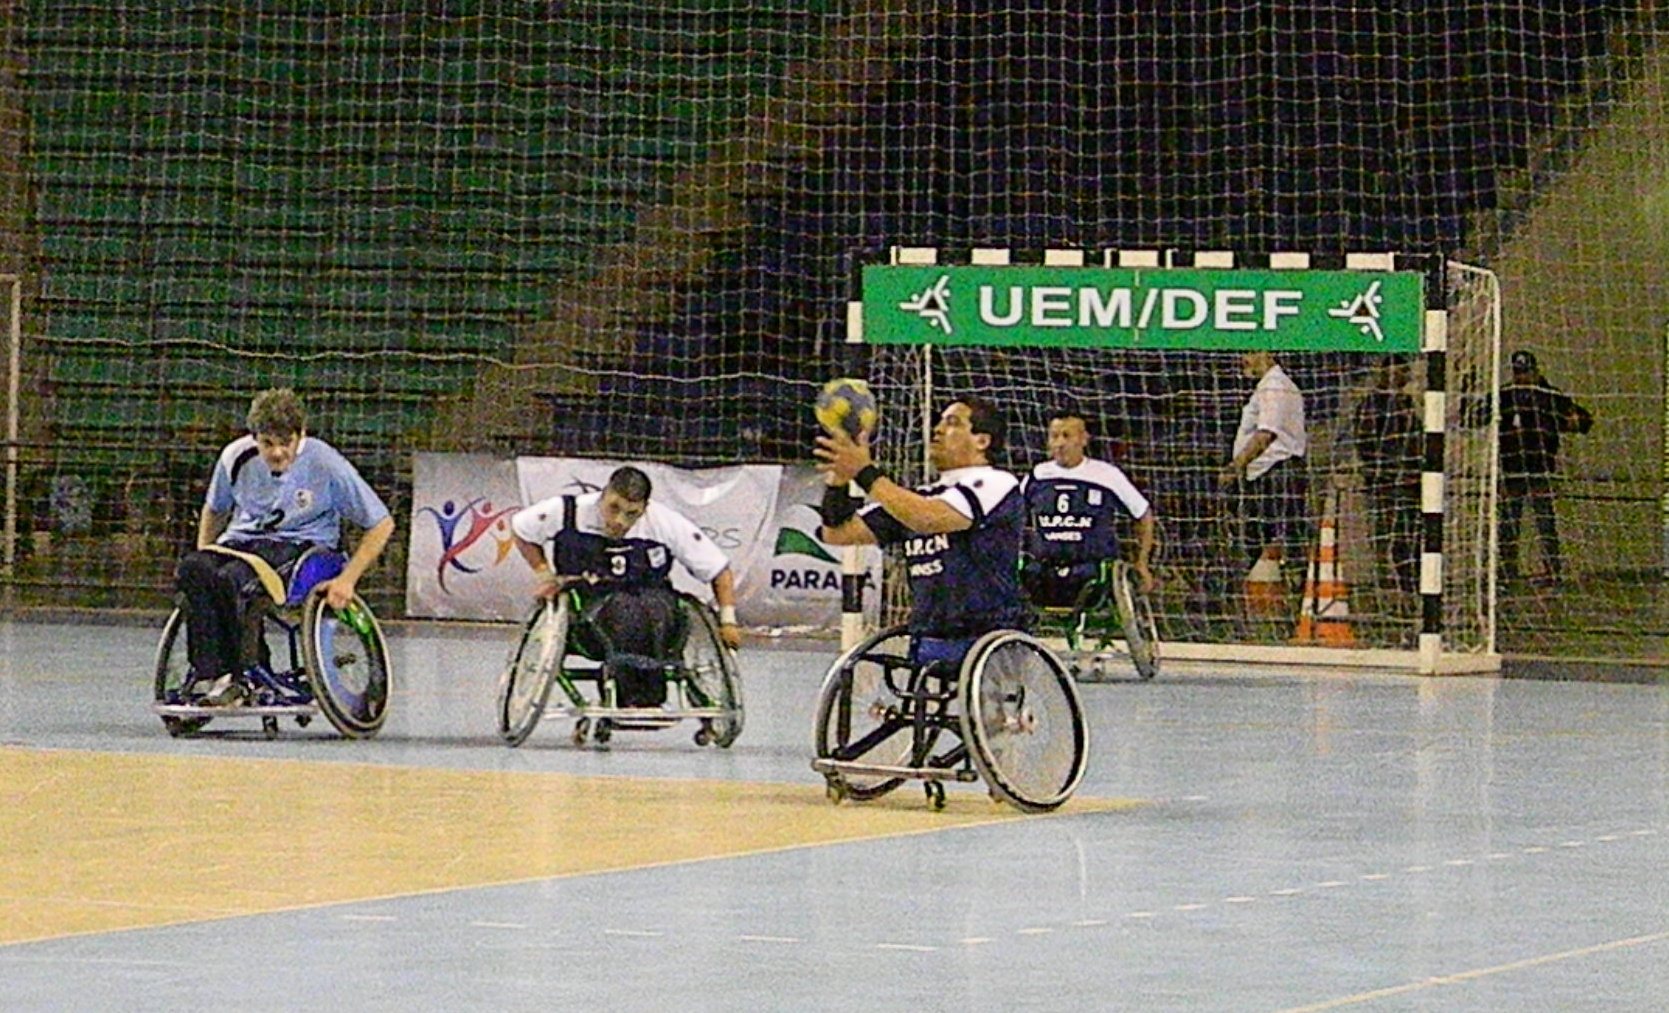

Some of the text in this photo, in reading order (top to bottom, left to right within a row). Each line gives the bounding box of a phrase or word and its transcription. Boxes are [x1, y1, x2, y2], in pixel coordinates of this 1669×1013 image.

[979, 285, 1303, 330] UEM/DEF
[1057, 493, 1070, 513] 6
[770, 566, 877, 591] PARAÁ
